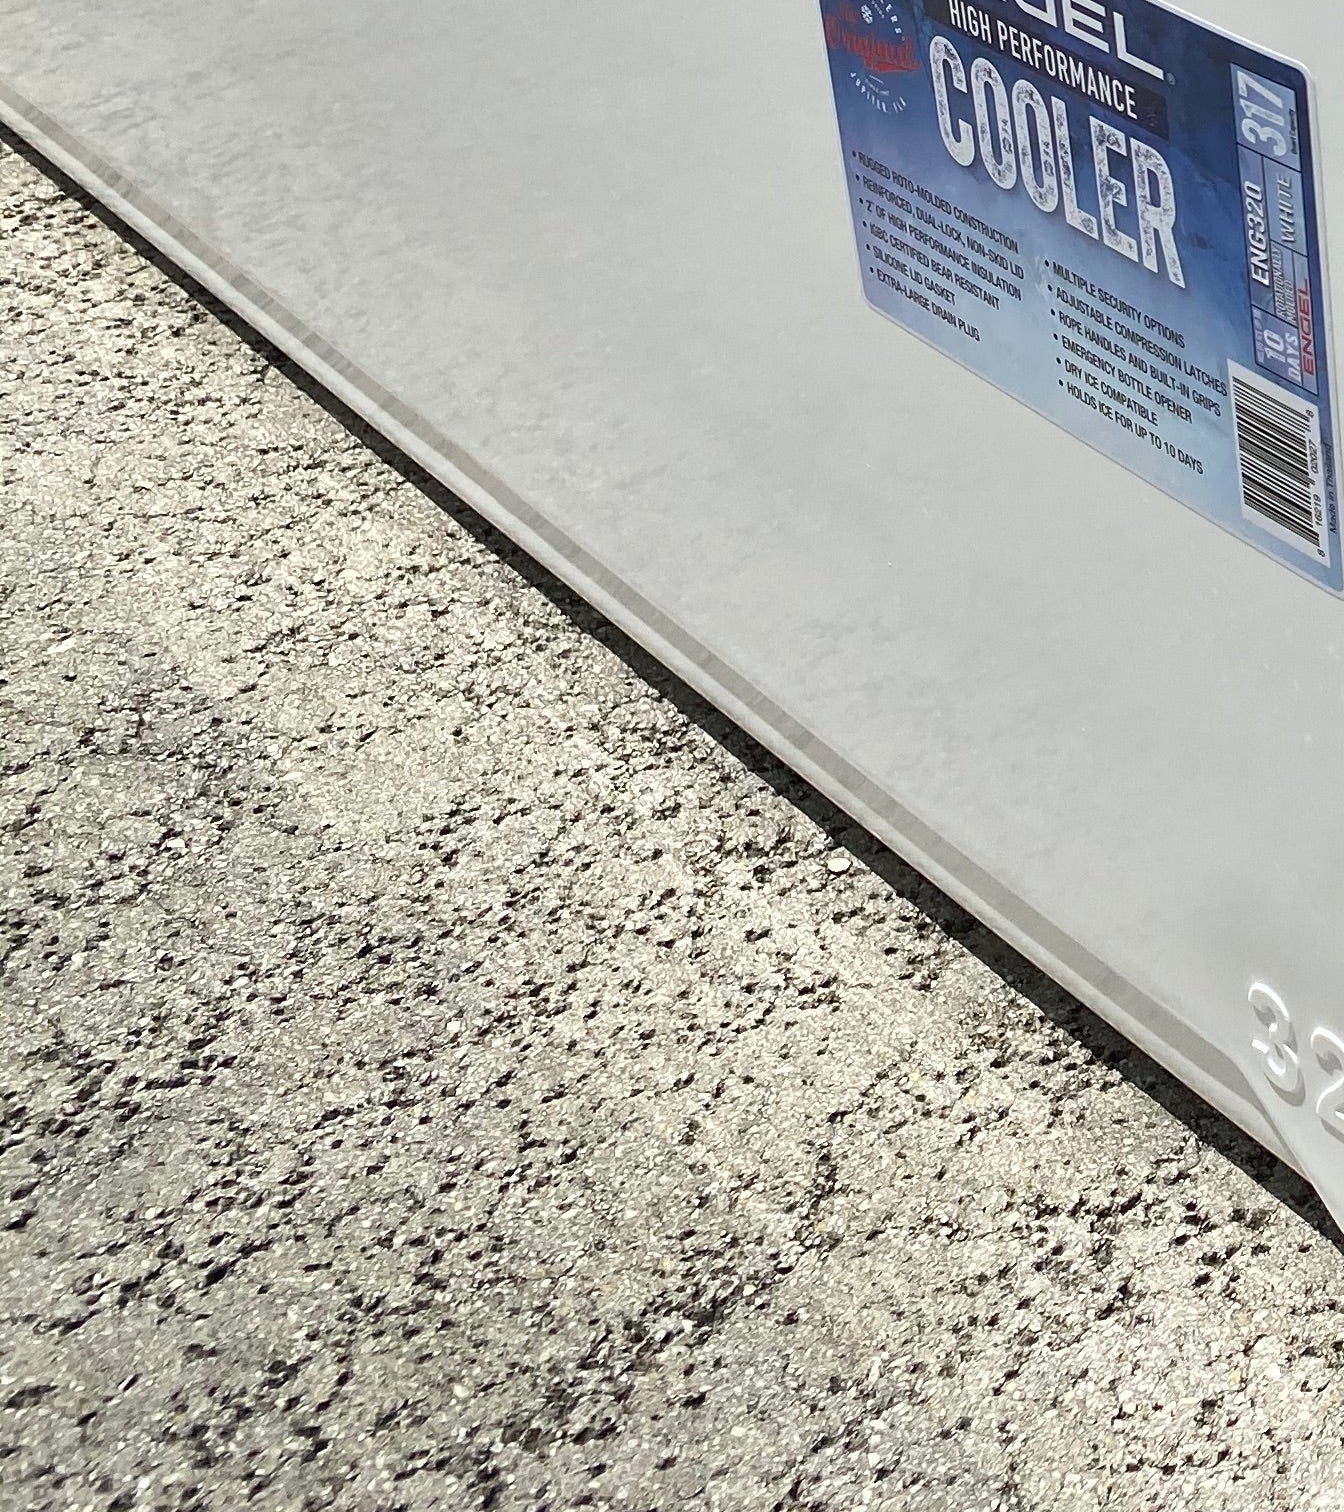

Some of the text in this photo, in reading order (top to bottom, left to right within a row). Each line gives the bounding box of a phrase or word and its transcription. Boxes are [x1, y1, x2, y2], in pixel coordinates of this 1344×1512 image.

[997, 23, 1139, 120] PERFORMANCE
[1237, 70, 1287, 157] 317
[929, 34, 1187, 290] COOLER
[858, 151, 1019, 254] RUGGED ROTO-MOLDED CONSTRUCTION
[863, 175, 1024, 279] REINFORCED, DUAL-LOCK, NON-SKID LID
[1244, 180, 1270, 287] ENG320
[1277, 174, 1295, 243] WHITE
[873, 246, 956, 305] SILICONE LID GASKET
[876, 205, 885, 220] OF
[887, 212, 907, 233] HIGH
[908, 224, 970, 270] PERFORMANCE
[971, 260, 1022, 301] INSULATION
[889, 234, 929, 268] CERTIFIED
[931, 259, 953, 281] BEAR
[955, 274, 1000, 310] RESISTANT
[1271, 245, 1287, 318] ROTATIONALLY
[876, 268, 980, 341] EXTRA-LARGE DRAIN PLUG
[1053, 262, 1185, 348] MULTIPLE SECURITY OPTIONS
[1283, 279, 1297, 325] MOLDED
[1298, 279, 1315, 376] ENGEL
[1056, 287, 1228, 396] ADJUSTABLE COMPRESSION LATCHES
[1059, 311, 1221, 417] ROPE HANDLES AND BUILT-IN GRIPS
[1263, 329, 1286, 363] 10
[1285, 332, 1301, 382] DAYS
[1062, 336, 1193, 424] EMERGENCY BOTTLE OPENER
[1065, 359, 1158, 427] DRY ICE COMPATIBLE
[1067, 381, 1203, 474] HOLDS ICE FOR UP TO 10 DAYS
[1309, 439, 1318, 474] 02027
[1322, 442, 1334, 488] Thailand
[1313, 493, 1322, 526] 16219
[1328, 491, 1335, 502] in
[1317, 548, 1326, 558] 8
